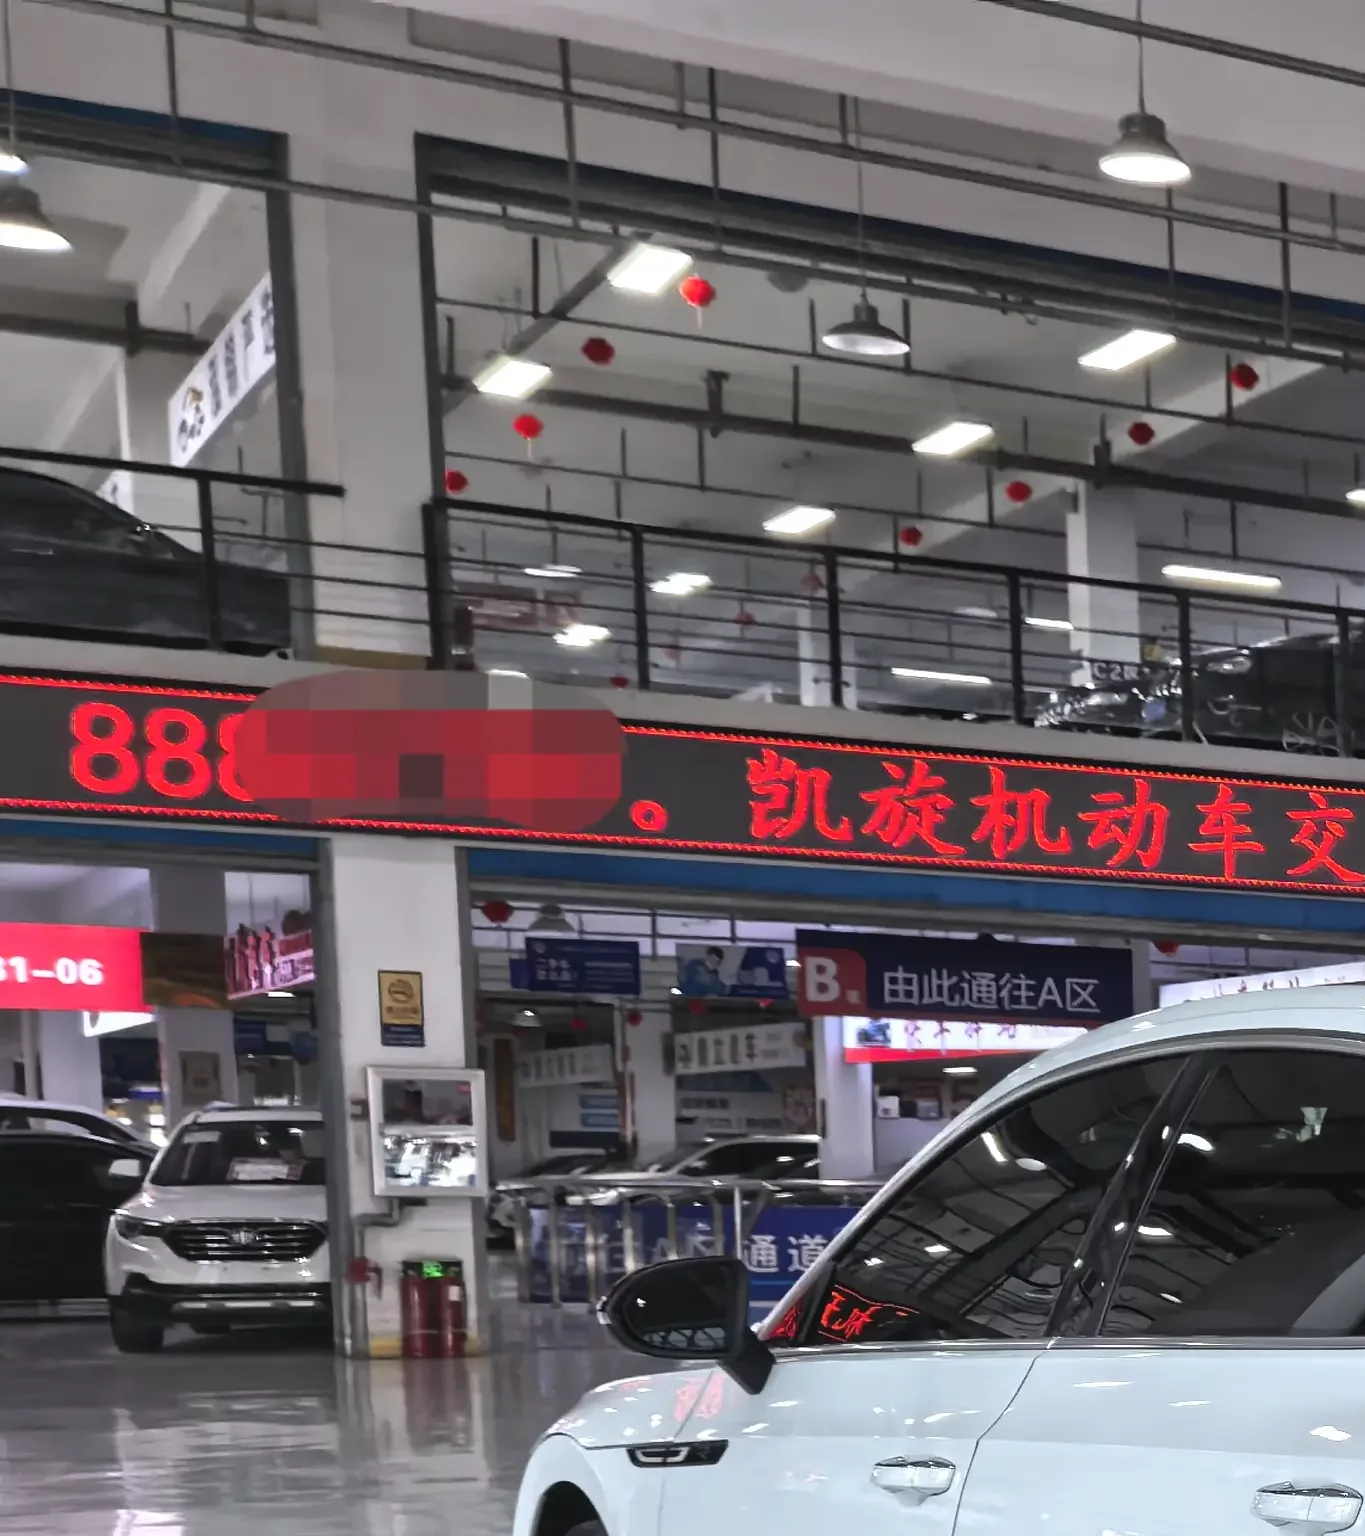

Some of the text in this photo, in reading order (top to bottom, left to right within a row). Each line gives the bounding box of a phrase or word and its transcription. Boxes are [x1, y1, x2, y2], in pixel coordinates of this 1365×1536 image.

[882, 965, 1101, 1013] 由此通往A区
